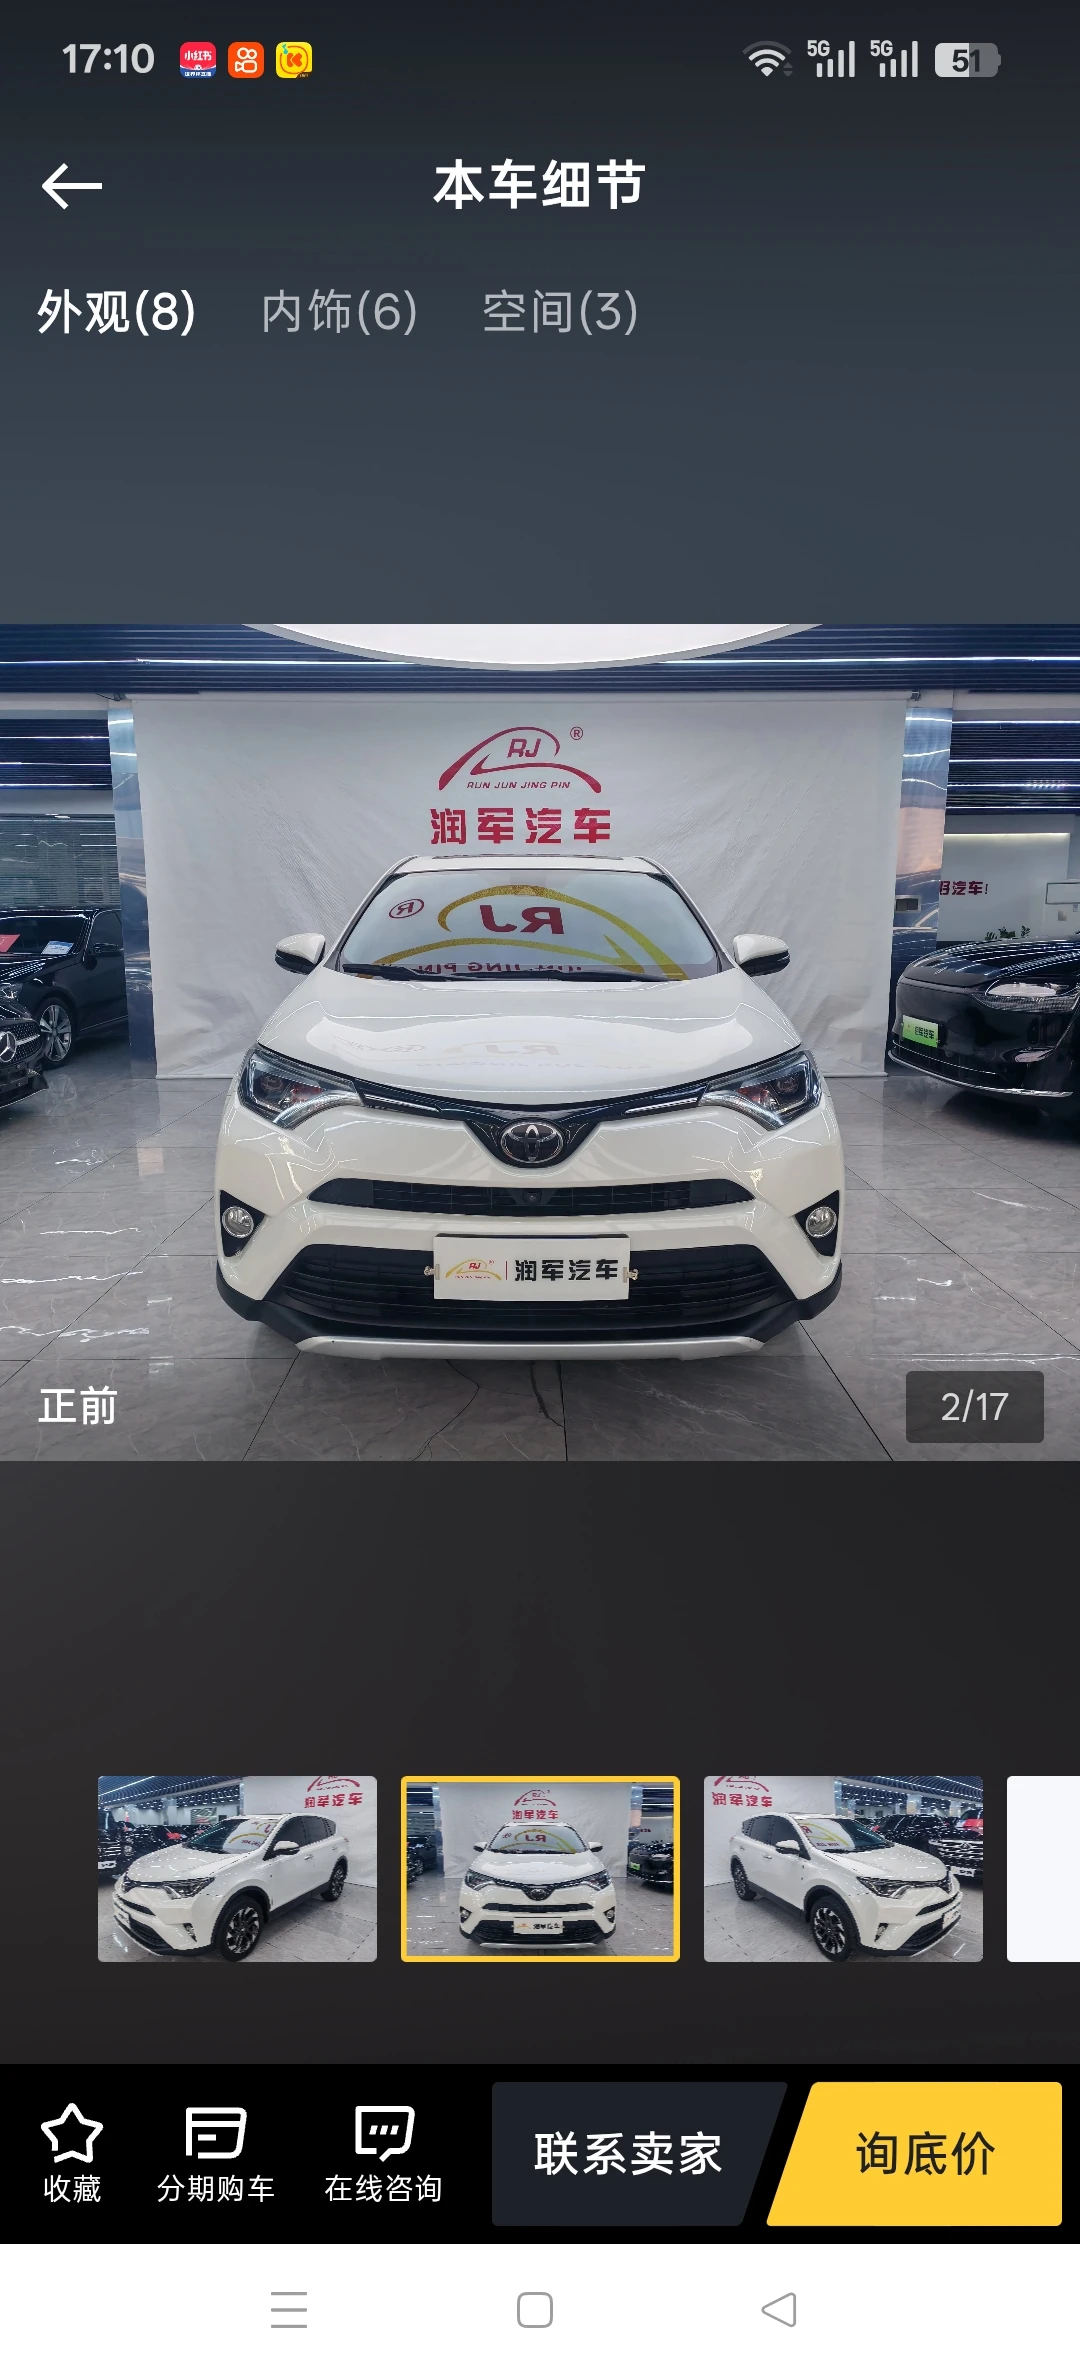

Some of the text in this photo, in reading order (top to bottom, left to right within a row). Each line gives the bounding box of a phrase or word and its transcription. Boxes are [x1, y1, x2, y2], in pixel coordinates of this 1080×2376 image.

[63, 44, 154, 73] 17:10
[184, 51, 212, 61] 小红书
[807, 40, 830, 57] 5G
[870, 40, 893, 57] 5G
[952, 49, 980, 72] 51
[433, 158, 645, 209] 本车细节
[37, 289, 195, 336] 外观(8)
[264, 289, 416, 336] 内饰(6)
[484, 289, 636, 336] 空间(3)
[507, 739, 541, 758] RJ
[430, 808, 611, 844] 润军汽车
[515, 1259, 618, 1281] 润军汽车
[534, 2131, 722, 2176] 联系卖家
[856, 2131, 995, 2176] 询底价
[44, 2174, 101, 2203] 收藏
[157, 2174, 274, 2203] 分期购车
[325, 2174, 441, 2203] 在线咨询
